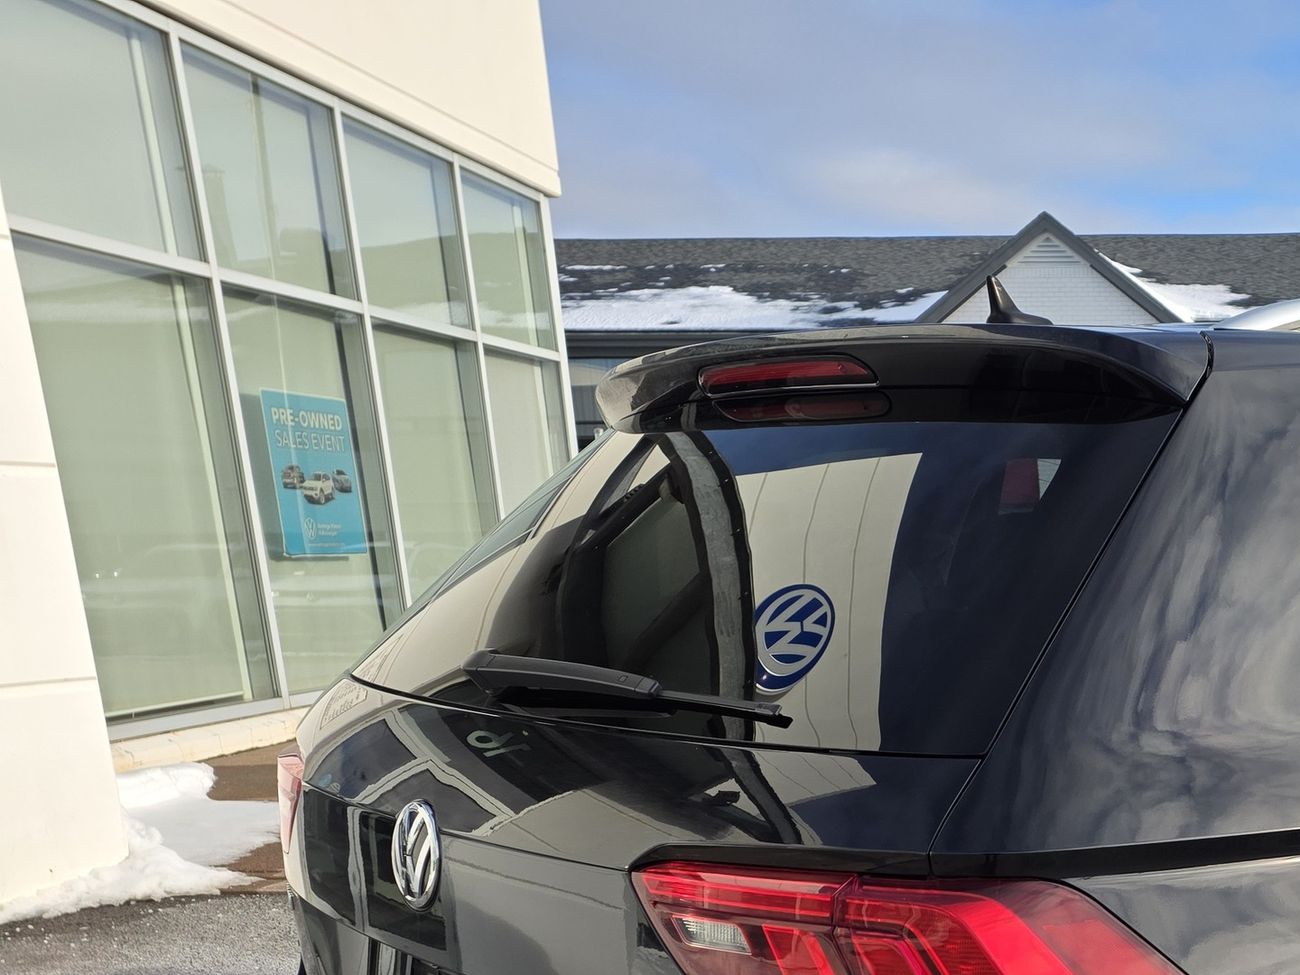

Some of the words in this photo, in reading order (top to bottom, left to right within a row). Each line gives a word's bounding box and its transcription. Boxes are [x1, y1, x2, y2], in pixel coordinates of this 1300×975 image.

[271, 406, 343, 431] PRE-OWNED
[274, 429, 309, 450] SALES
[312, 434, 345, 452] EVENT
